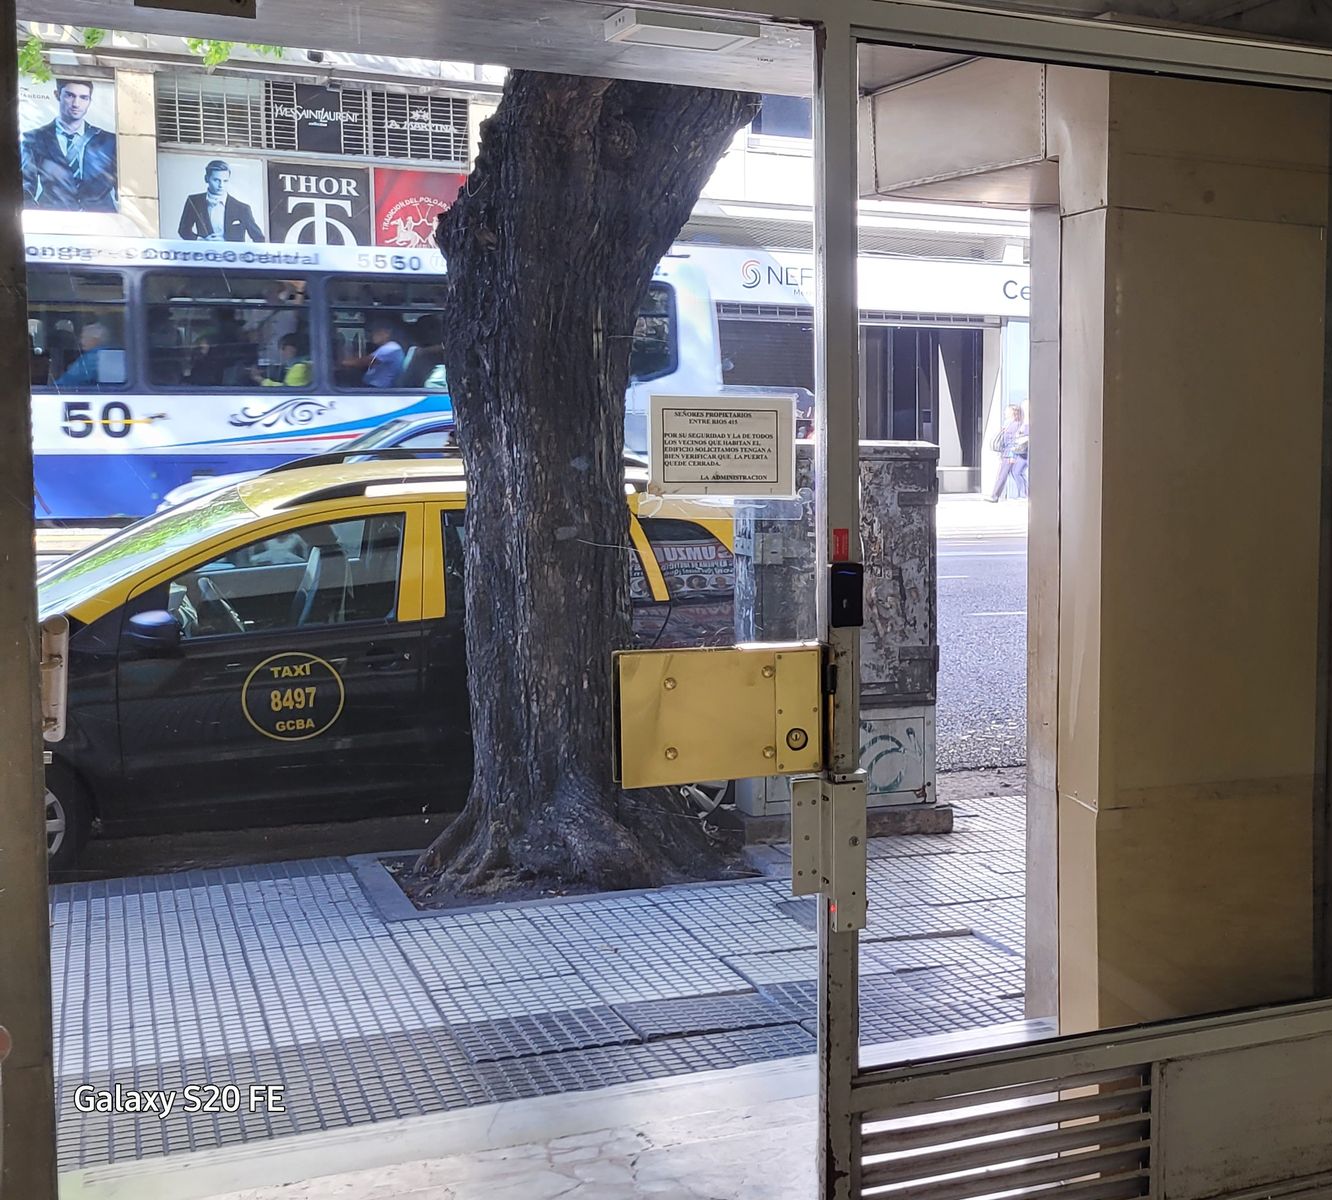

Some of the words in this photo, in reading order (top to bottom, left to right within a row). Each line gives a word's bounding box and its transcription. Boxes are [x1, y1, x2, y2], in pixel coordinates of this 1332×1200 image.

[279, 174, 360, 197] THOR
[382, 201, 405, 230] TRADICION
[405, 197, 419, 206] DEL
[420, 196, 438, 204] POLO
[62, 400, 134, 439] 50
[674, 410, 704, 418] SEÑORES
[270, 664, 312, 678] TAXI
[270, 686, 317, 712] 8497
[276, 718, 316, 732] GCBA
